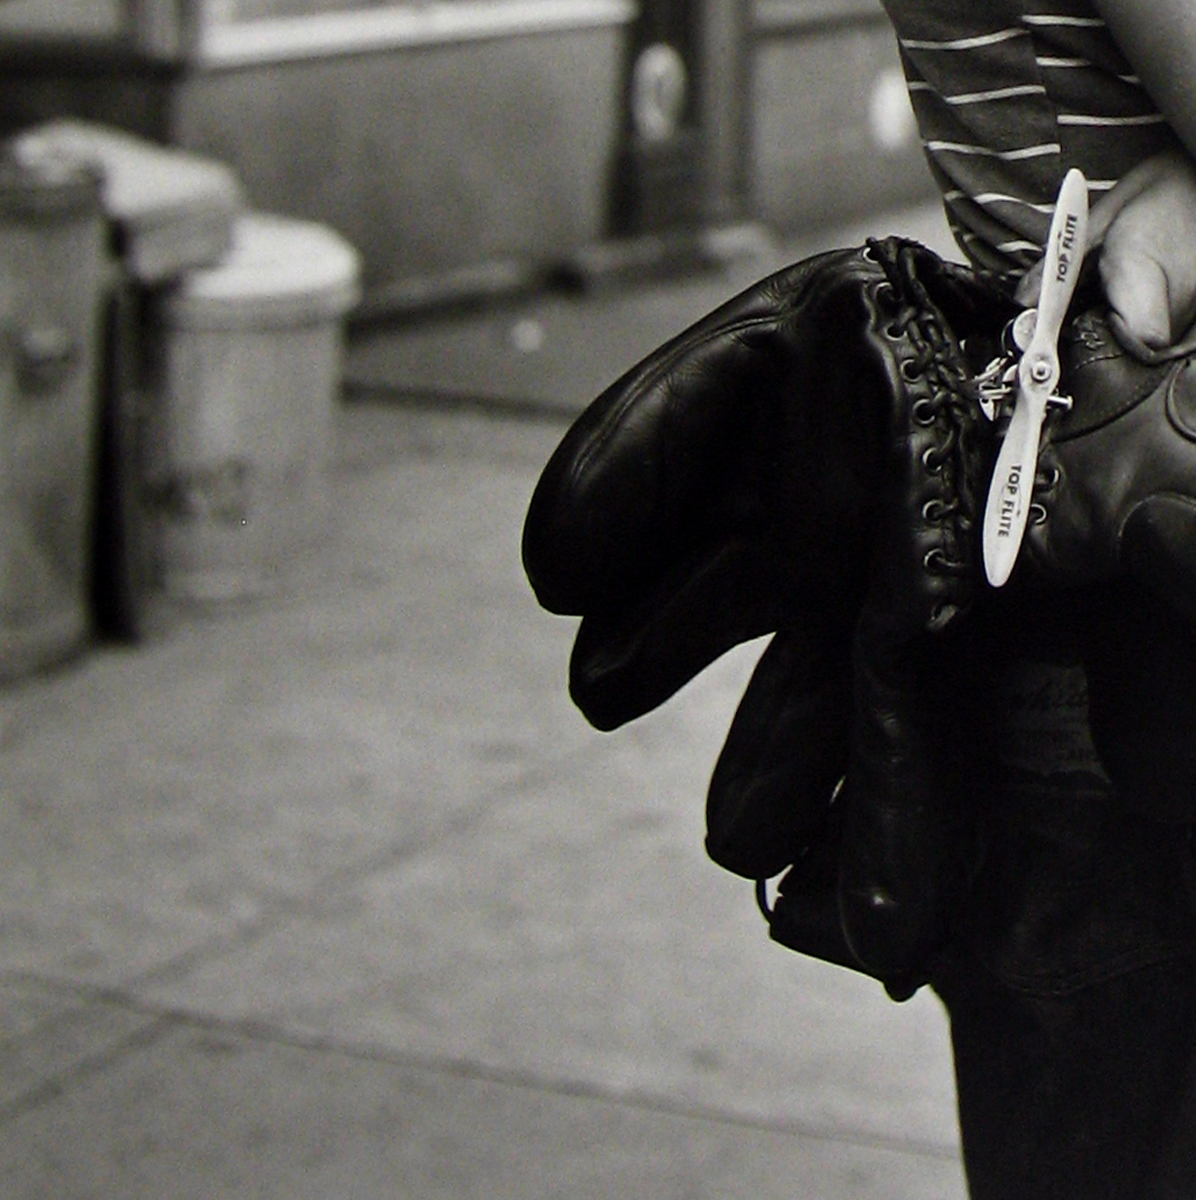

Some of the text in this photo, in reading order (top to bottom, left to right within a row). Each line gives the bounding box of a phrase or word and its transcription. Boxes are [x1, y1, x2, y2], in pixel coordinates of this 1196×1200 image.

[1056, 214, 1078, 282] TOP FLITE
[997, 464, 1022, 537] TOP FLITE
